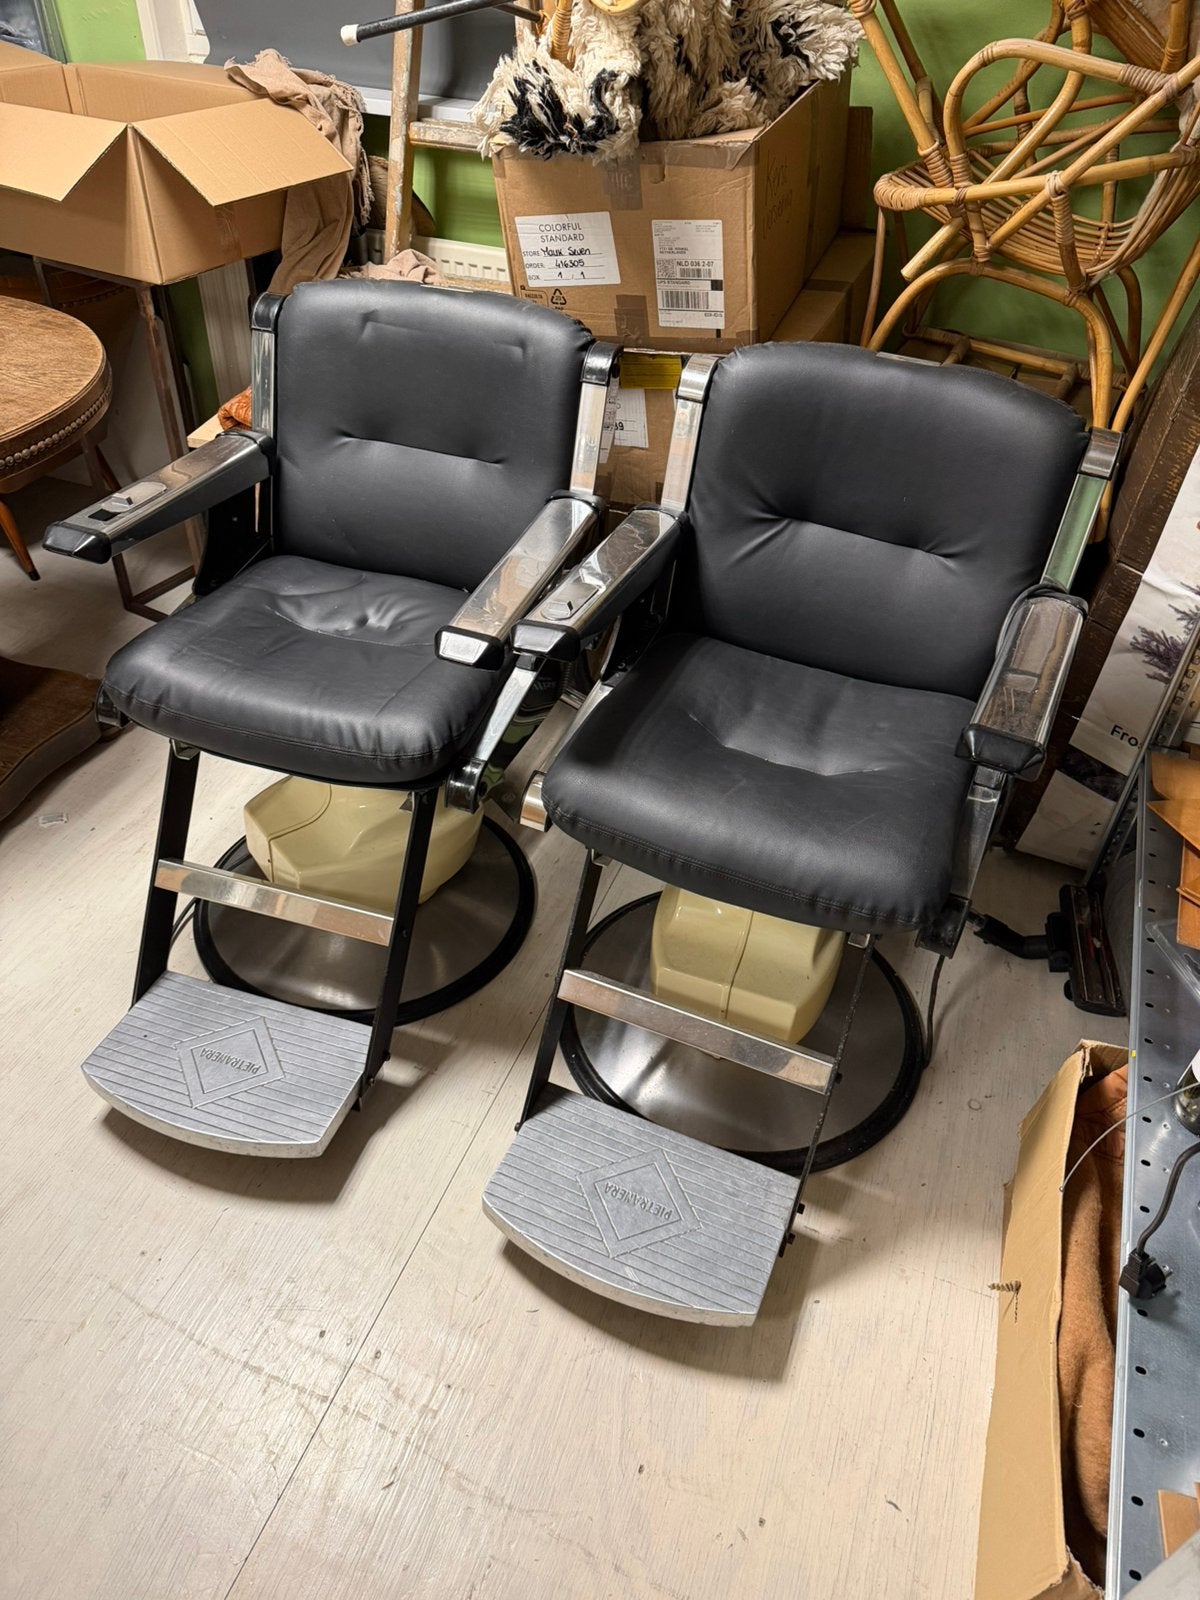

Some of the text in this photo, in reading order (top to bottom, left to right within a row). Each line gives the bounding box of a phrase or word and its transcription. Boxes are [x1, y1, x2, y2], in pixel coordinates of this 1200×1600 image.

[538, 222, 582, 232] COLORFUL
[540, 233, 585, 243] STANDARD
[555, 259, 585, 268] 416305
[557, 271, 563, 279] 1
[580, 271, 586, 279] 1
[199, 1047, 261, 1075] PIETRANERA
[604, 1181, 673, 1221] PIETRANERA
